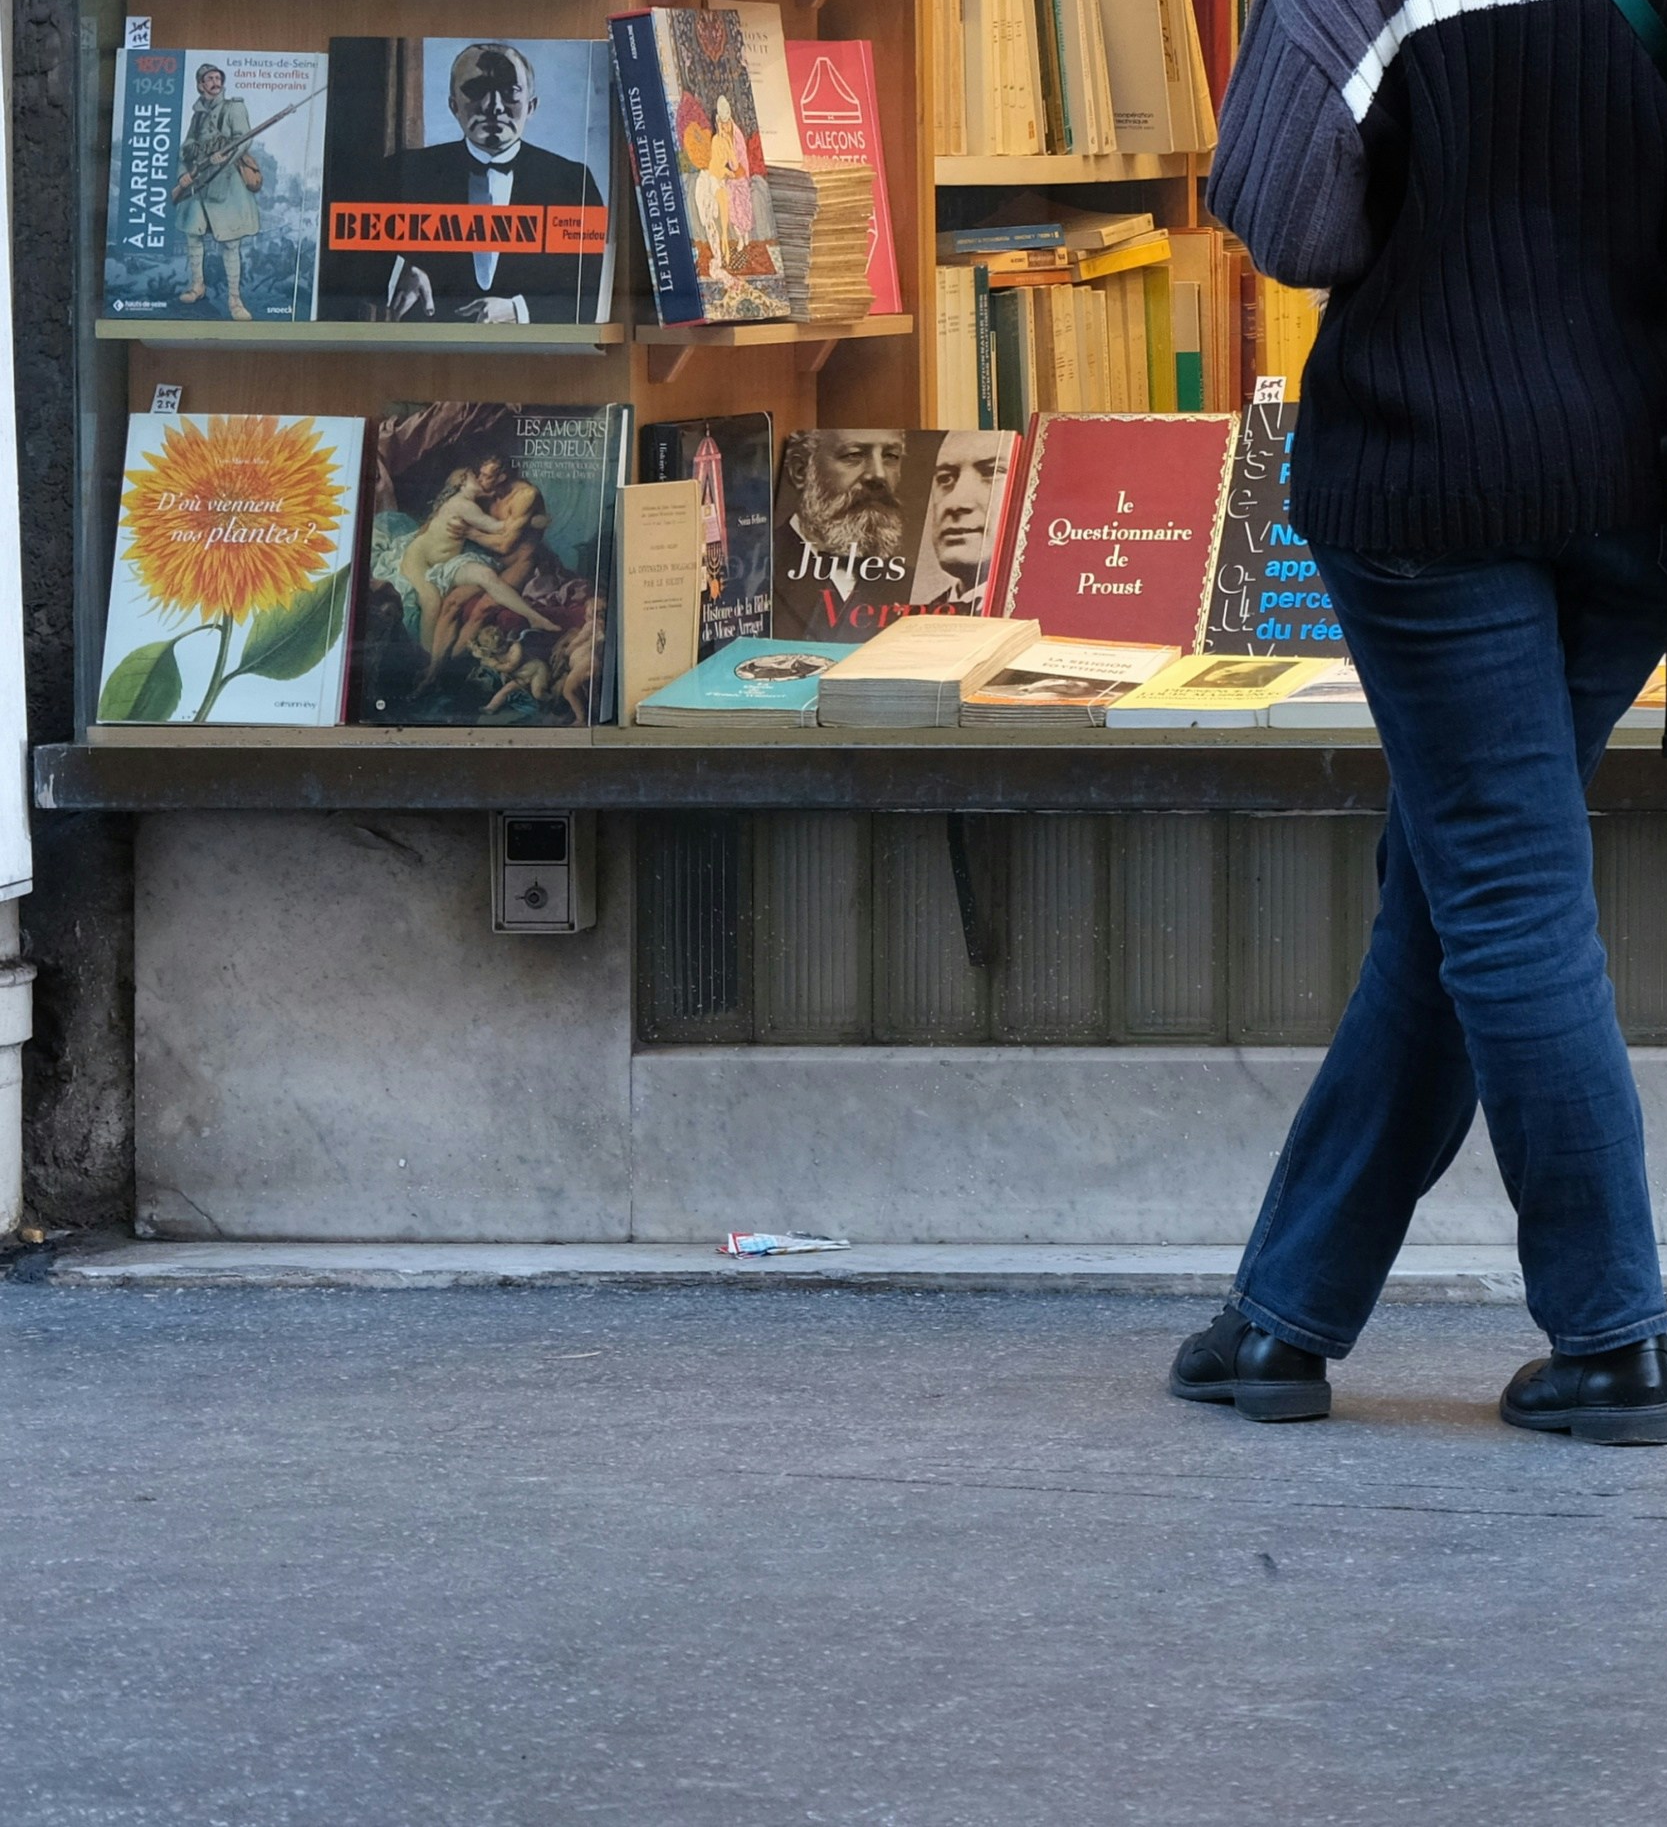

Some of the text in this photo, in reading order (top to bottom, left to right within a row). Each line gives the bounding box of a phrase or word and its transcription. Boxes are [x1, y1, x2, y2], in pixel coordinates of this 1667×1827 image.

[132, 78, 175, 95] 1945
[235, 80, 307, 92] contemporains
[806, 131, 865, 153] CALEÇONS
[334, 212, 538, 243] BECKMANN
[516, 419, 606, 438] LES AMOURS
[524, 439, 596, 457] DES DIEUX
[157, 491, 283, 513] D'où viennent
[1116, 491, 1134, 514] le
[171, 527, 201, 542] nos
[205, 516, 298, 549] plantes
[1048, 518, 1192, 546] Questionnaire
[788, 541, 906, 582] Jules
[1105, 544, 1129, 568] de
[1077, 572, 1143, 596] Proust
